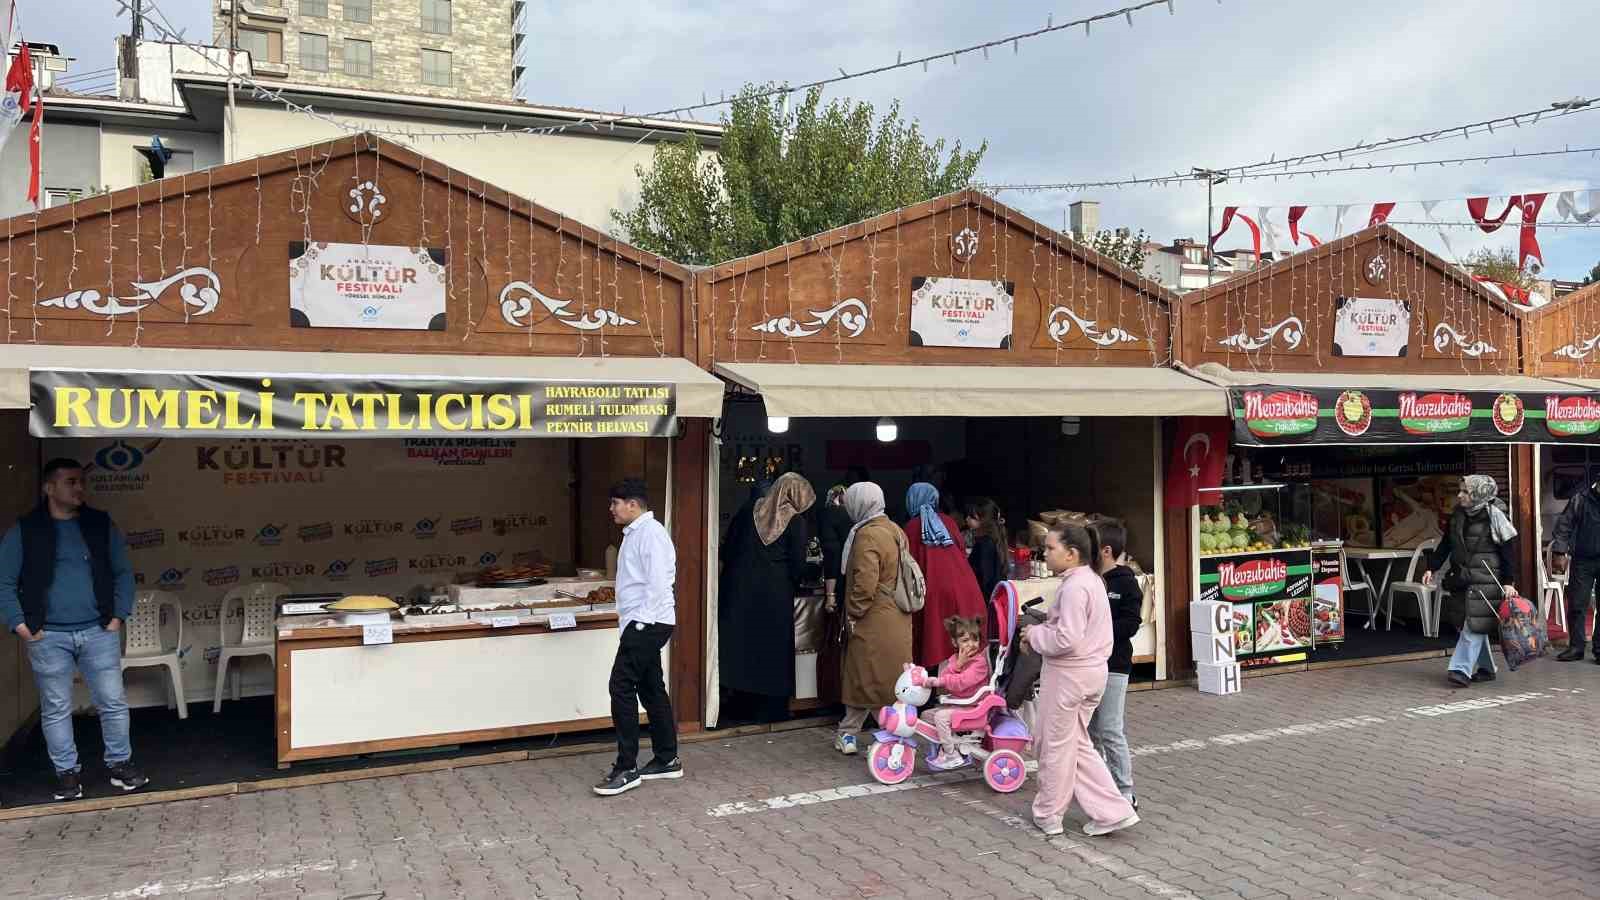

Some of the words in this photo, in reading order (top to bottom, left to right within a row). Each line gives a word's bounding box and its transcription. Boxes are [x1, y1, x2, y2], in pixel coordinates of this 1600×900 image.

[320, 263, 416, 284] KÜLTÜR
[931, 294, 994, 311] KÜLTÜR
[1350, 312, 1397, 325] KÜLTÜR
[545, 386, 621, 399] HAYRABOLU
[623, 387, 670, 399] TATLISI
[53, 378, 276, 430] RUMELİ
[292, 392, 533, 431] TATLICISI
[546, 402, 594, 416] RUMELİ
[599, 403, 668, 416] TULUMBASI
[1245, 391, 1318, 420] Mevzubahis
[1399, 392, 1472, 417] Mevzubahis
[546, 418, 593, 433] PEYNİR
[597, 420, 649, 433] HELVASI
[197, 444, 347, 470] KÜLTÜR
[178, 528, 247, 542] KÜLTÜR
[343, 521, 405, 536] KÜLTÜR
[251, 563, 317, 578] KÜLTÜR
[408, 556, 467, 569] KÜLTÜR
[1219, 558, 1287, 587] Mevzubahis
[1214, 604, 1232, 634] G
[1215, 635, 1233, 662] N
[1224, 664, 1238, 692] H
